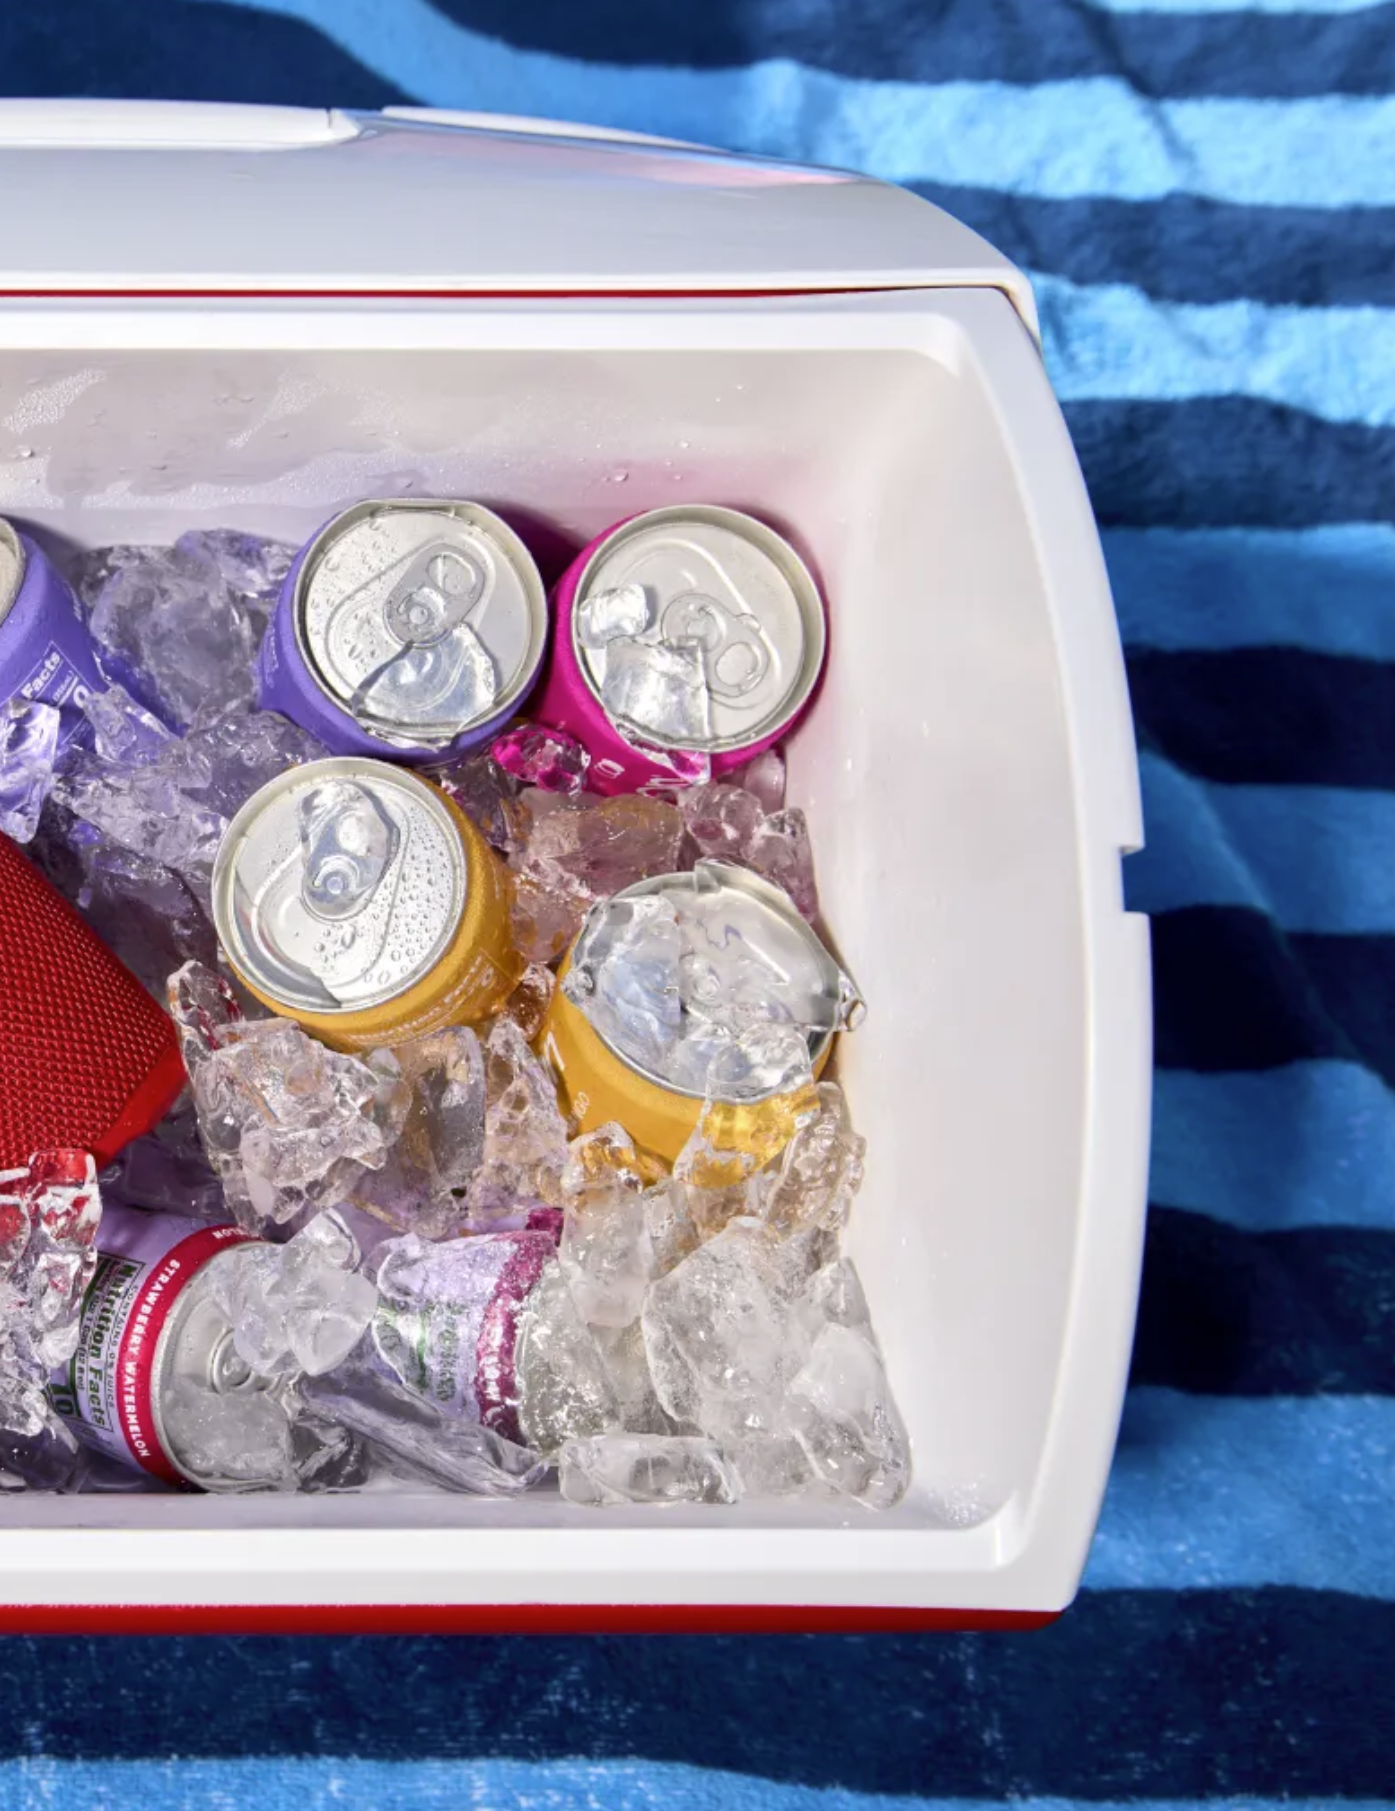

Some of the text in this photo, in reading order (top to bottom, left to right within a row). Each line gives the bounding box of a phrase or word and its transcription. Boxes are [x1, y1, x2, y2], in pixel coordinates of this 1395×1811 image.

[21, 652, 61, 699] Facts
[90, 1263, 138, 1360] Nutrition
[122, 1259, 181, 1457] STRAWBERRY WATERMELON
[89, 1366, 106, 1426] Facts
[107, 1374, 115, 1409] JUICE
